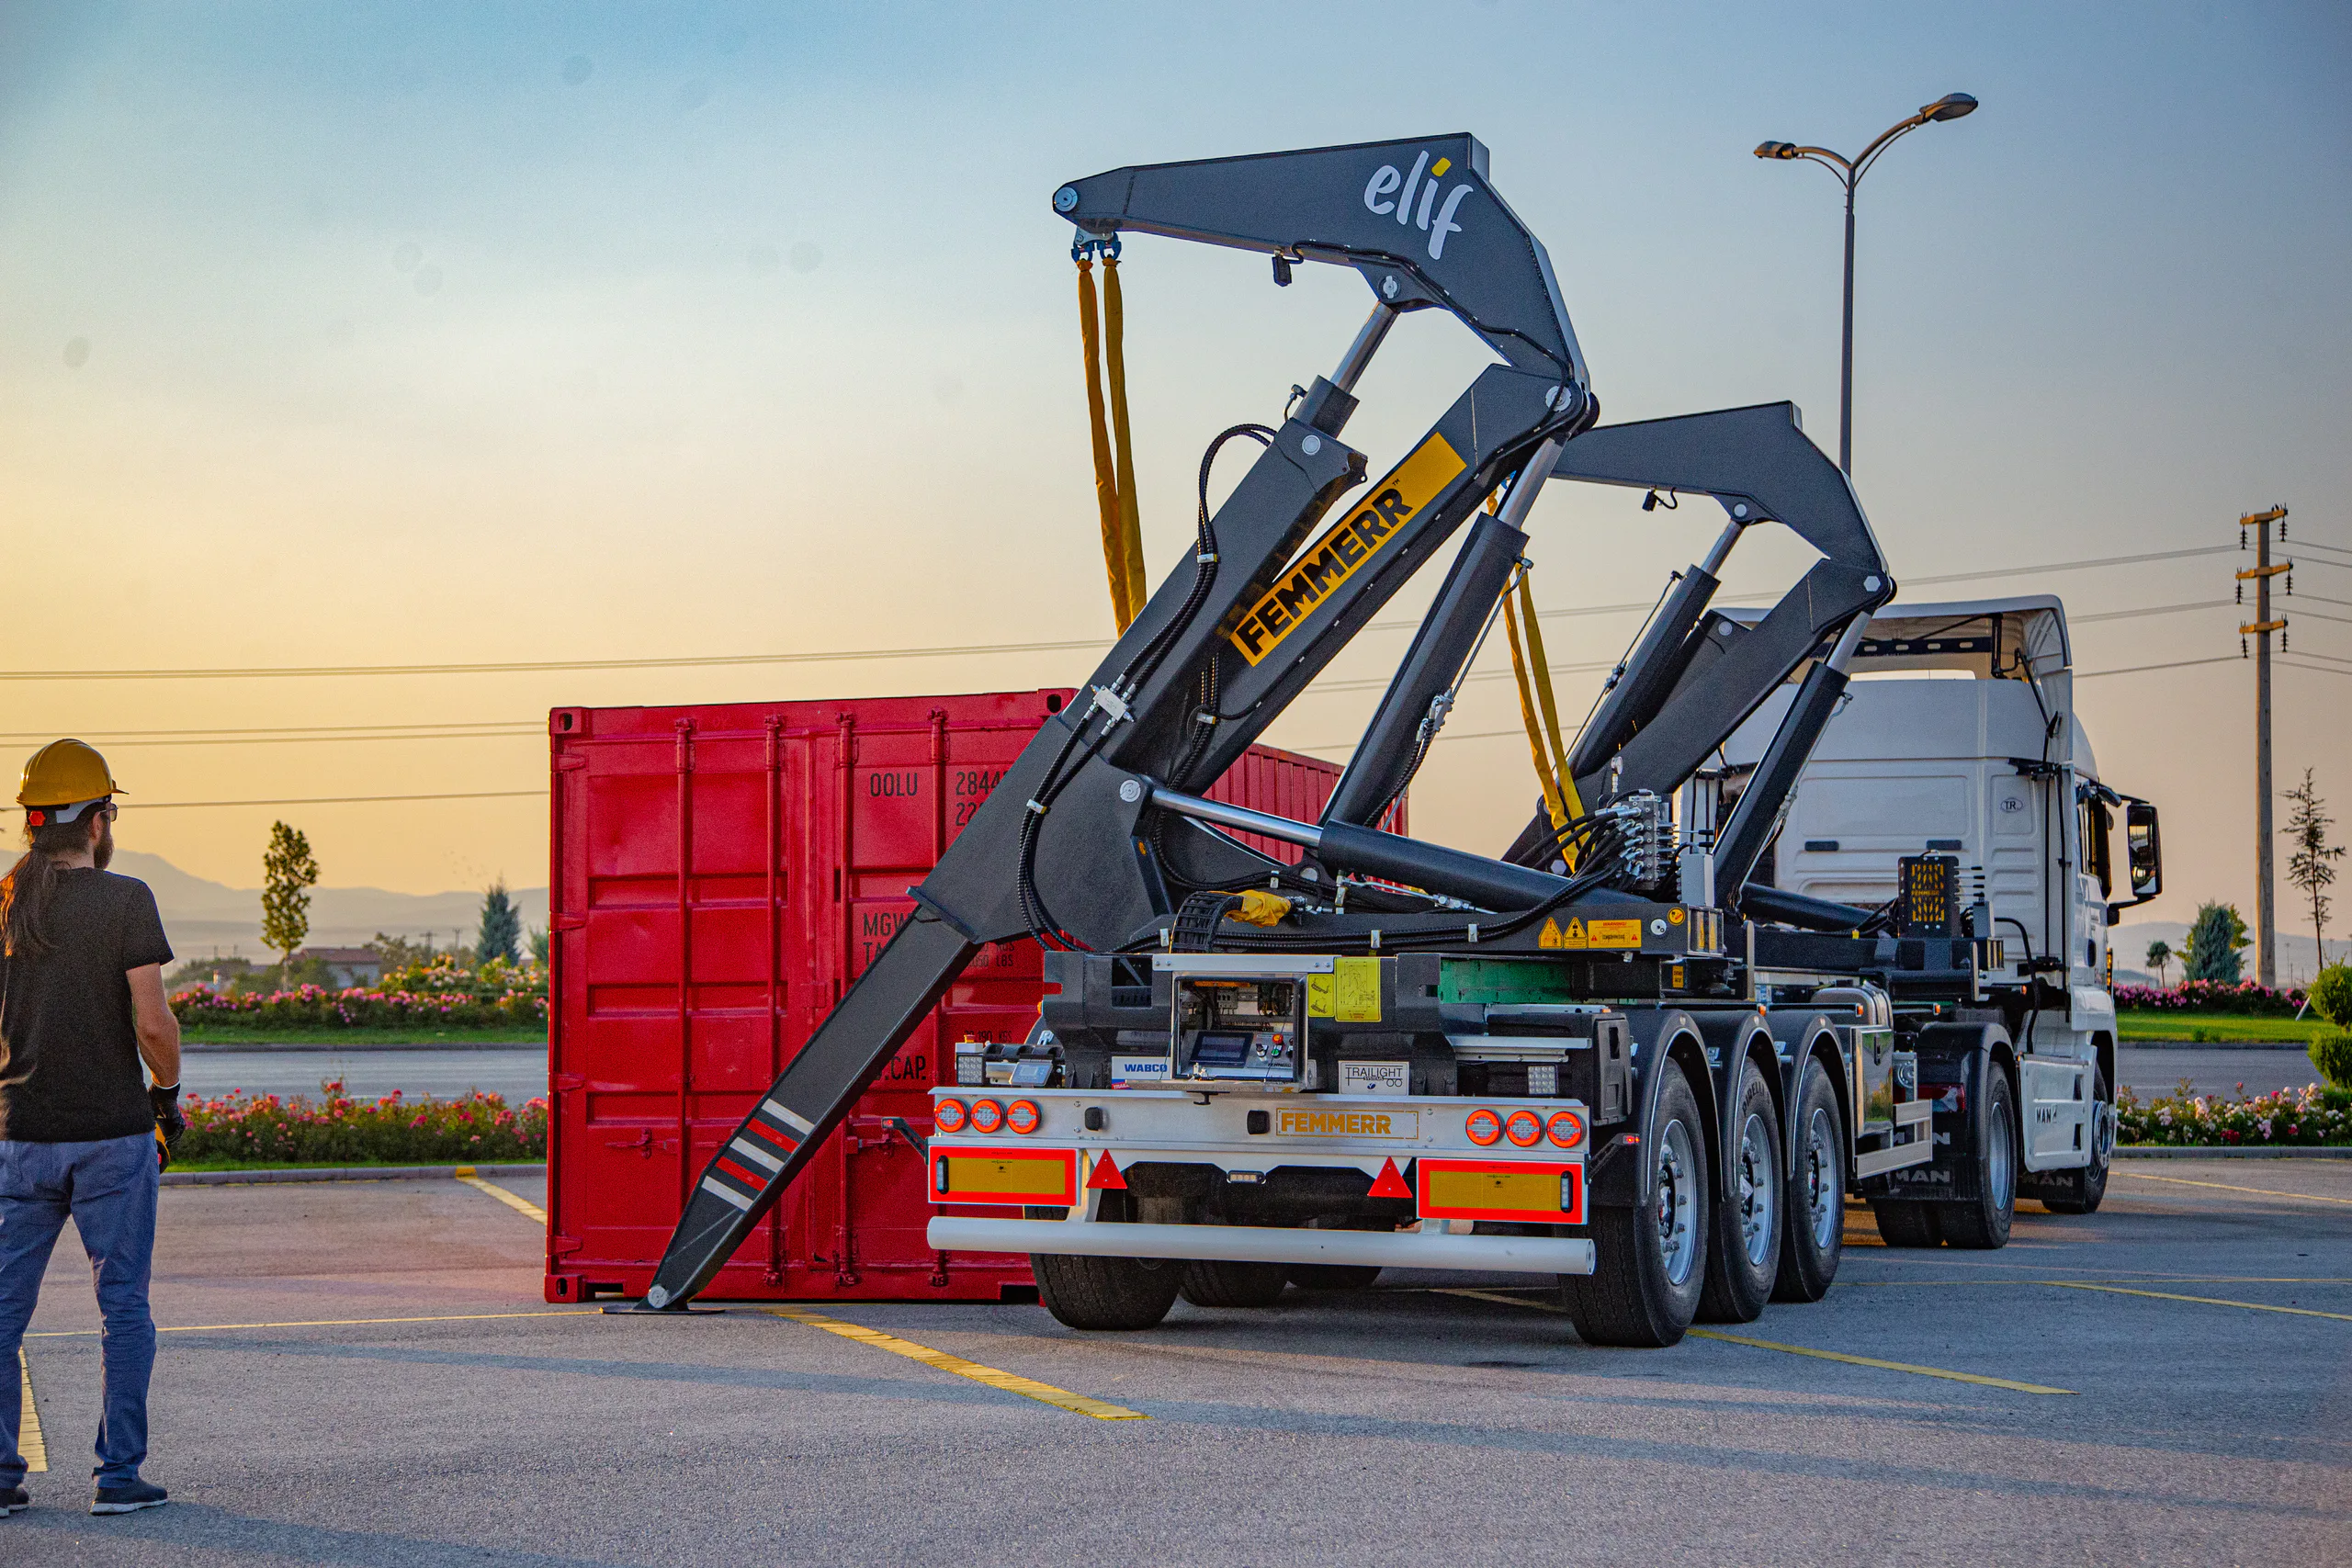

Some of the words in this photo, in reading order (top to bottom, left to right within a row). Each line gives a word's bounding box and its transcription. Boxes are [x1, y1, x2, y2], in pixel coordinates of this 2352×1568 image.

[1363, 150, 1474, 261] elif
[1235, 488, 1414, 657] FEMMERR
[956, 771, 1008, 796] 2844
[996, 953, 1013, 966] LBS
[1124, 1064, 1168, 1073] WABCO
[1345, 1066, 1404, 1082] TRAILIGHT
[1281, 1112, 1392, 1134] FEMMERR
[2036, 1107, 2052, 1124] MAN
